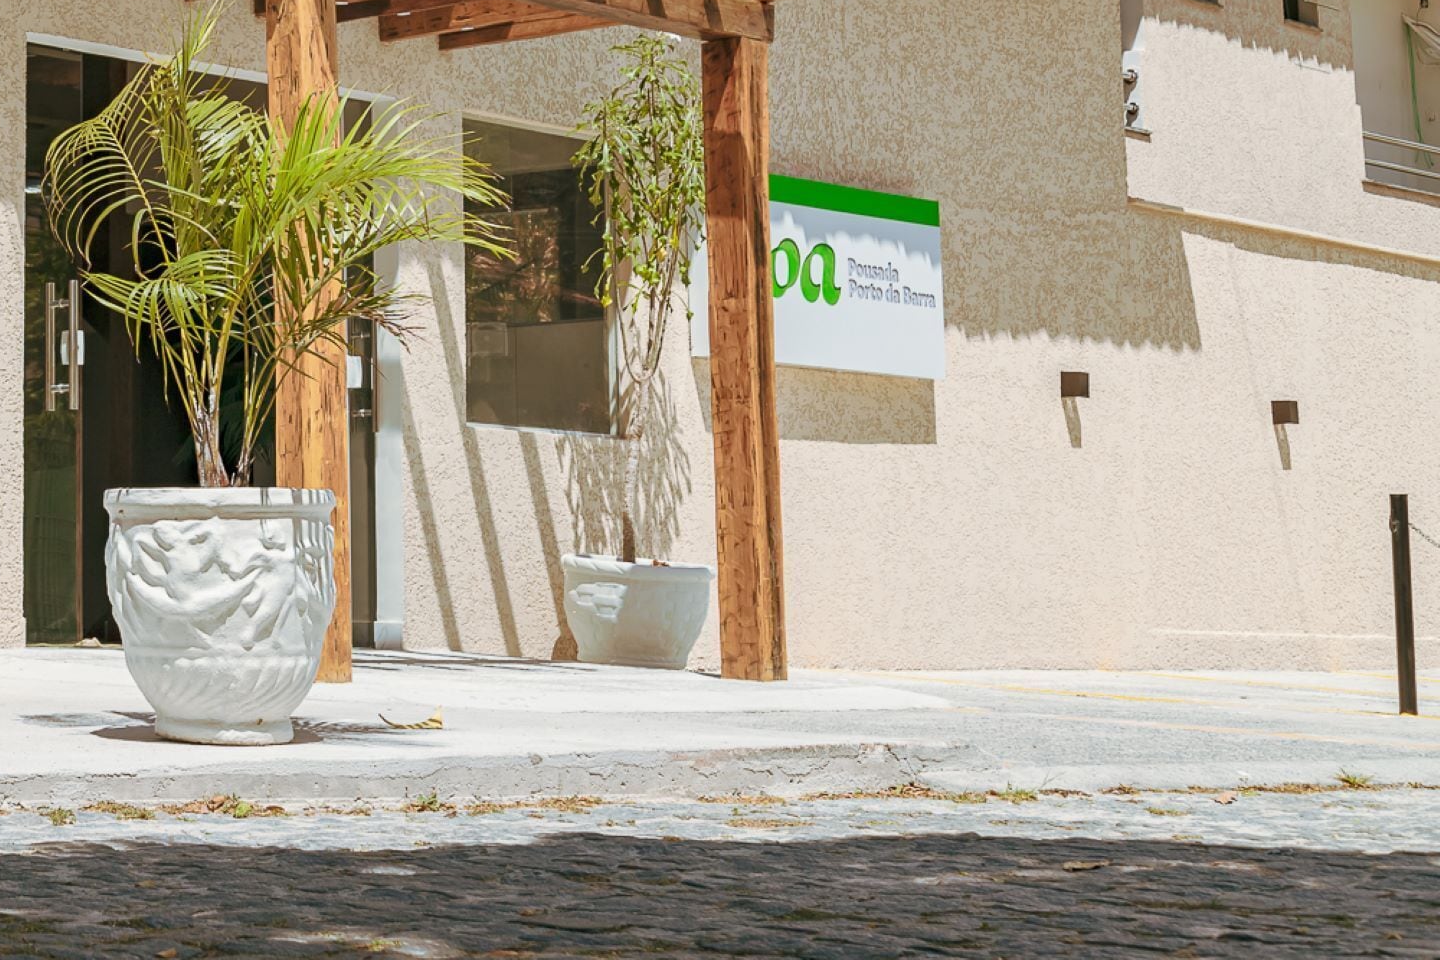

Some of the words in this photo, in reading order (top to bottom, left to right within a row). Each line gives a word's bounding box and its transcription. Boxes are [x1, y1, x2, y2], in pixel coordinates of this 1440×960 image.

[847, 257, 899, 283] Pousada
[848, 278, 883, 300] Porto
[885, 283, 900, 304] da
[902, 286, 936, 308] Barra
